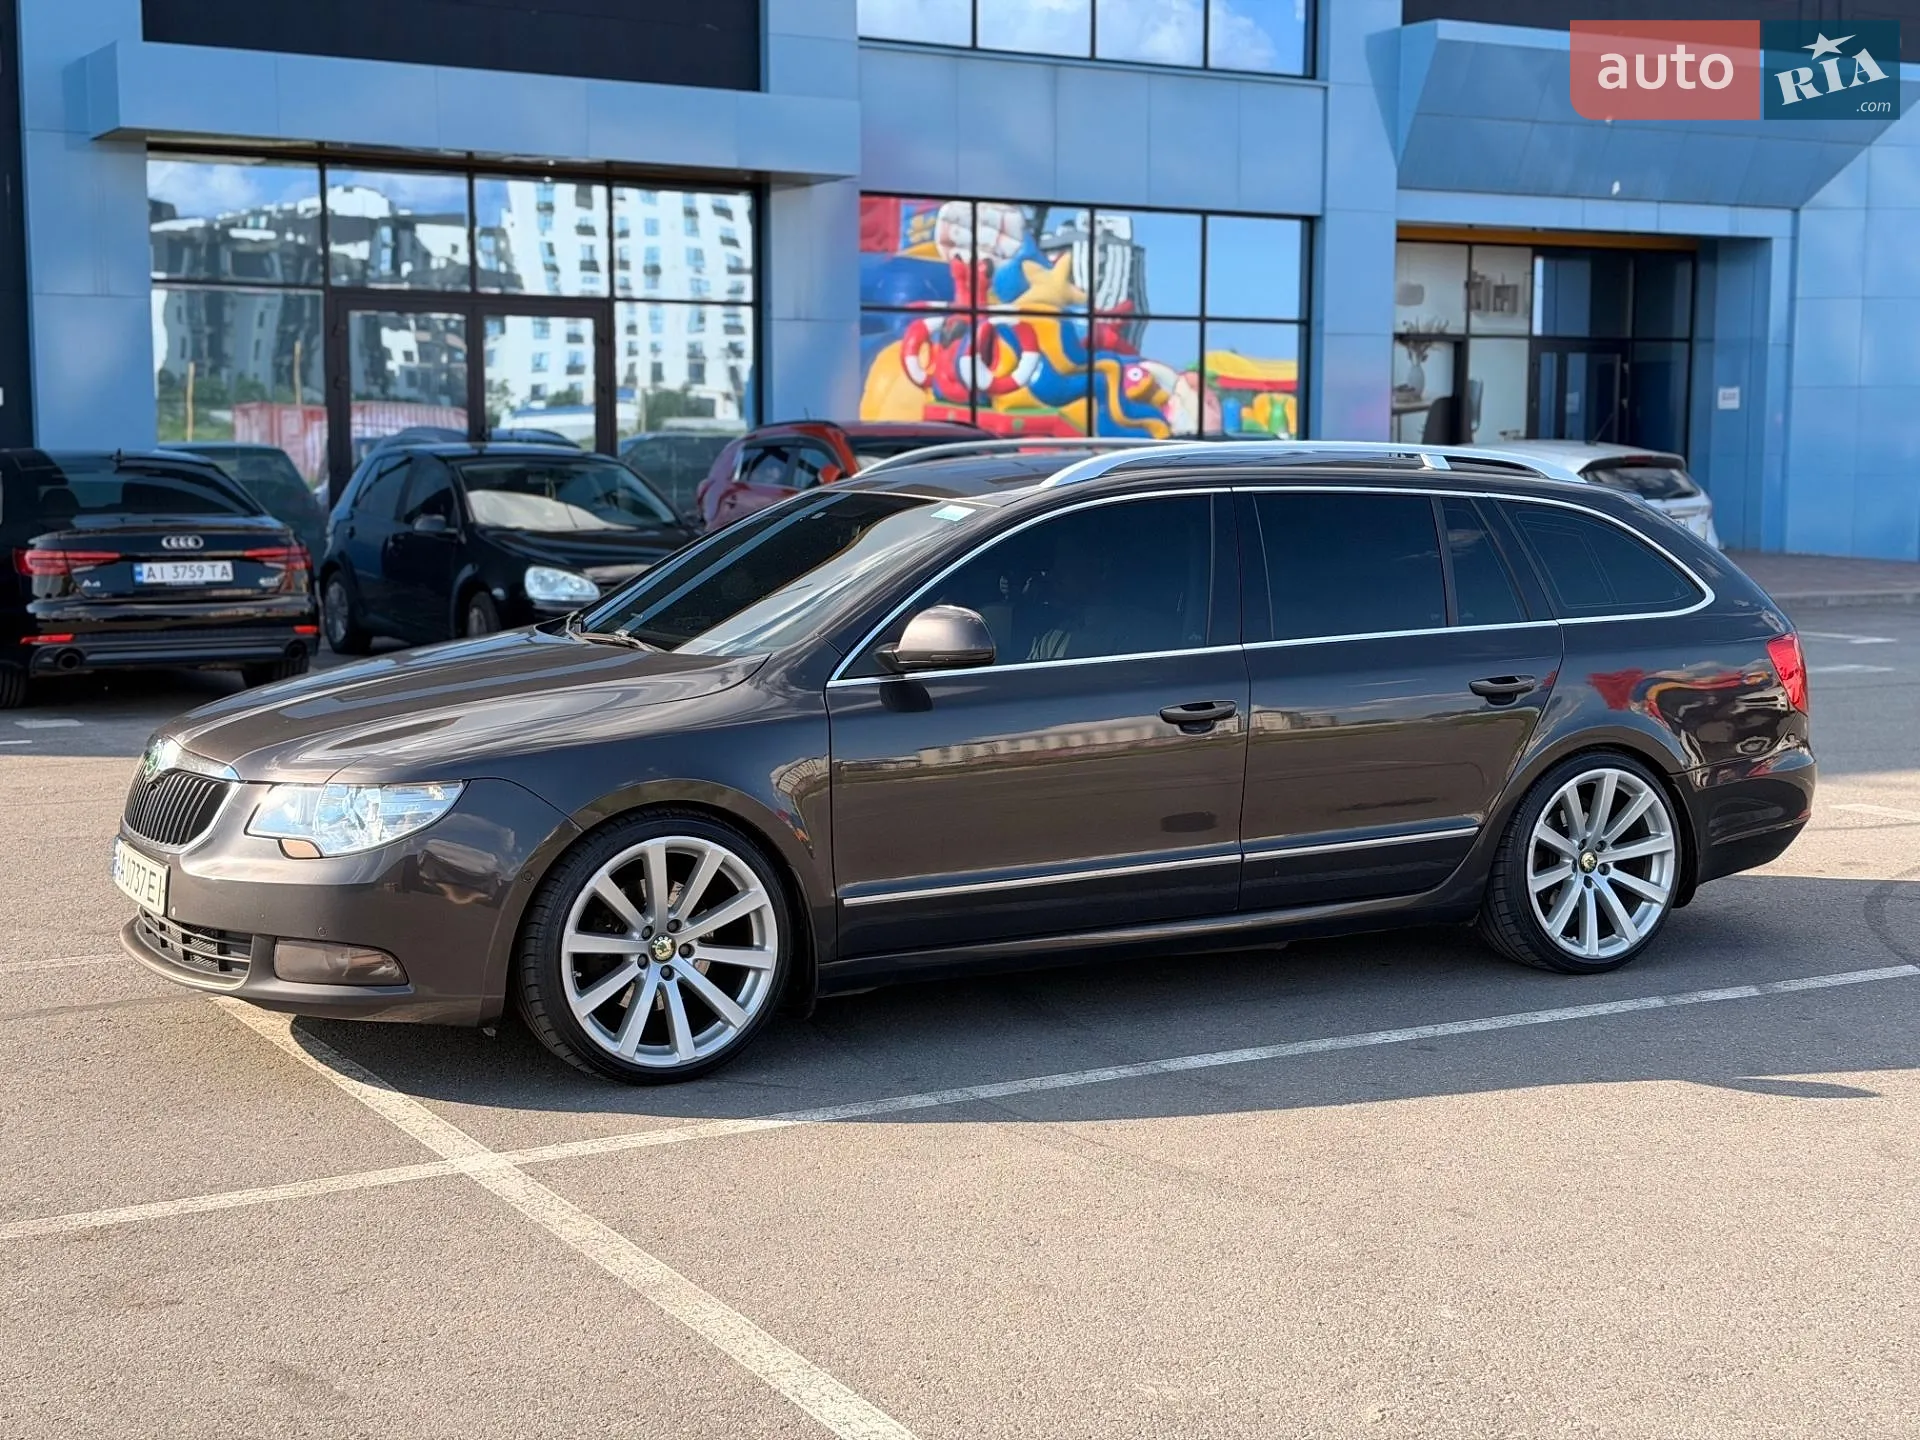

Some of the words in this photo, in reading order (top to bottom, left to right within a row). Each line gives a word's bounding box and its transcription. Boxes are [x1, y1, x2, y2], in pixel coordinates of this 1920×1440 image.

[146, 565, 165, 580] AI
[172, 564, 205, 580] 3759
[208, 563, 231, 579] TA
